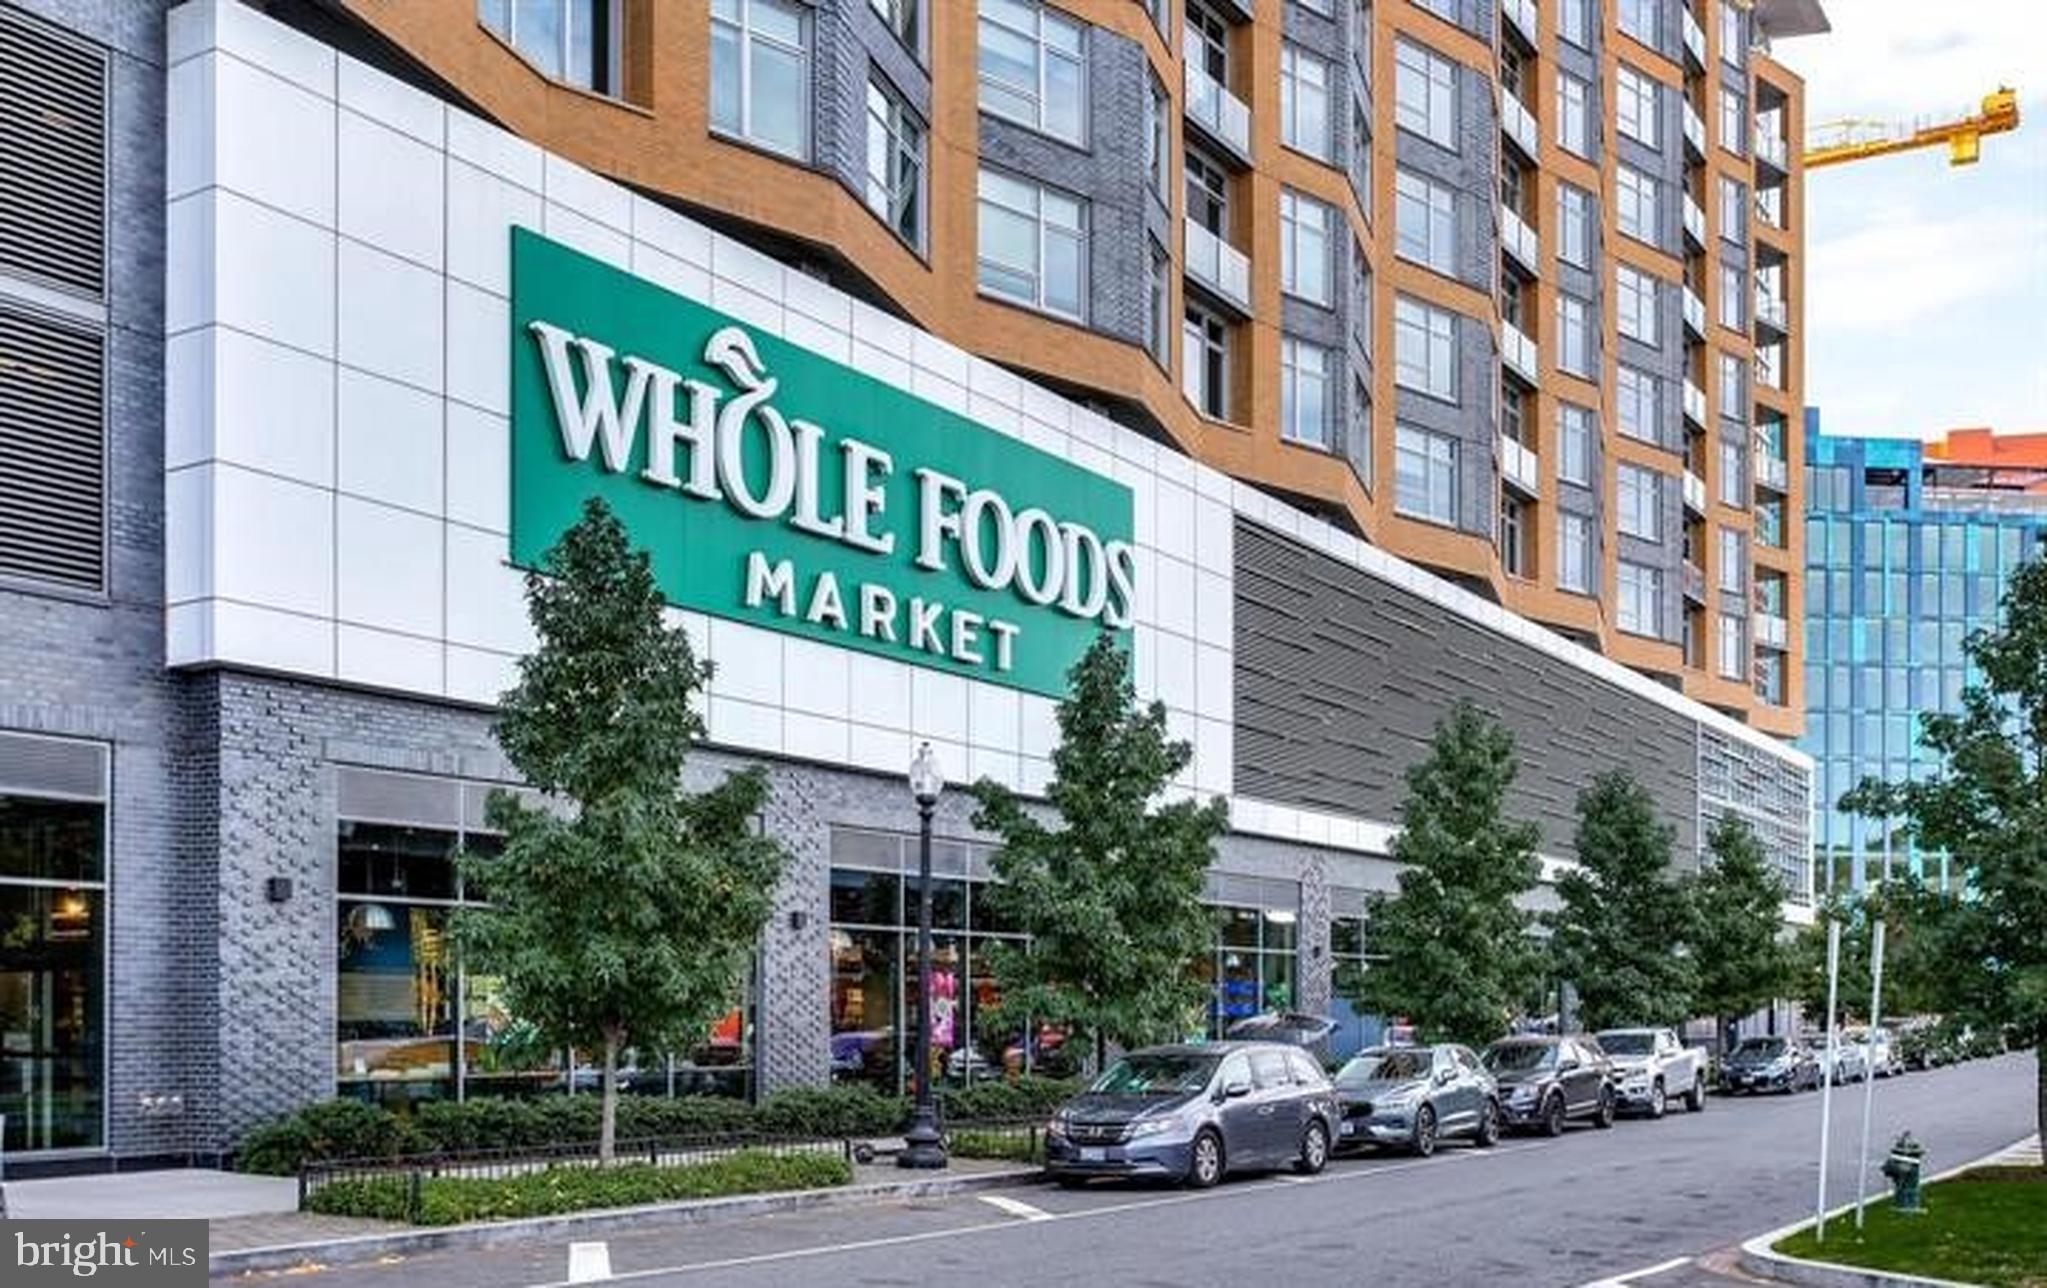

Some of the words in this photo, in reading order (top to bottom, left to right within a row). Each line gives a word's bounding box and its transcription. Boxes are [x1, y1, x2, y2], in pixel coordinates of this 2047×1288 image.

[528, 320, 895, 555] WHOLE
[914, 466, 1136, 630] FOODS
[745, 551, 1019, 671] MARKET
